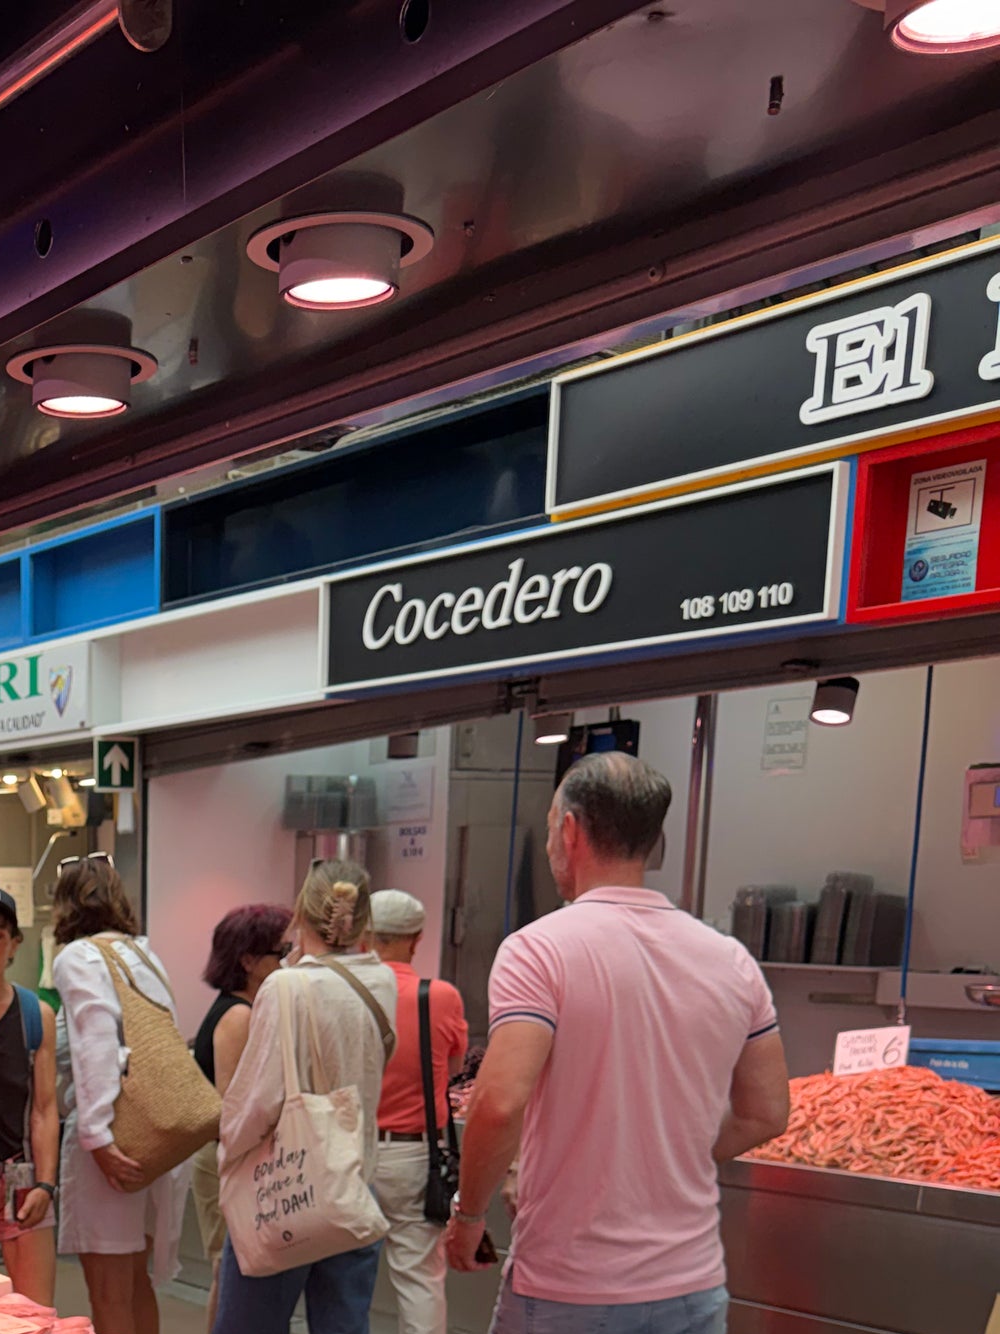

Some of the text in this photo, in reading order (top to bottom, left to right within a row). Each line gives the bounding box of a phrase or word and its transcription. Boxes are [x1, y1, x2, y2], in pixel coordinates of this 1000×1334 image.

[362, 557, 613, 650] Cocedero
[680, 582, 794, 620] 108 109 110
[282, 1185, 316, 1216] DAY!
